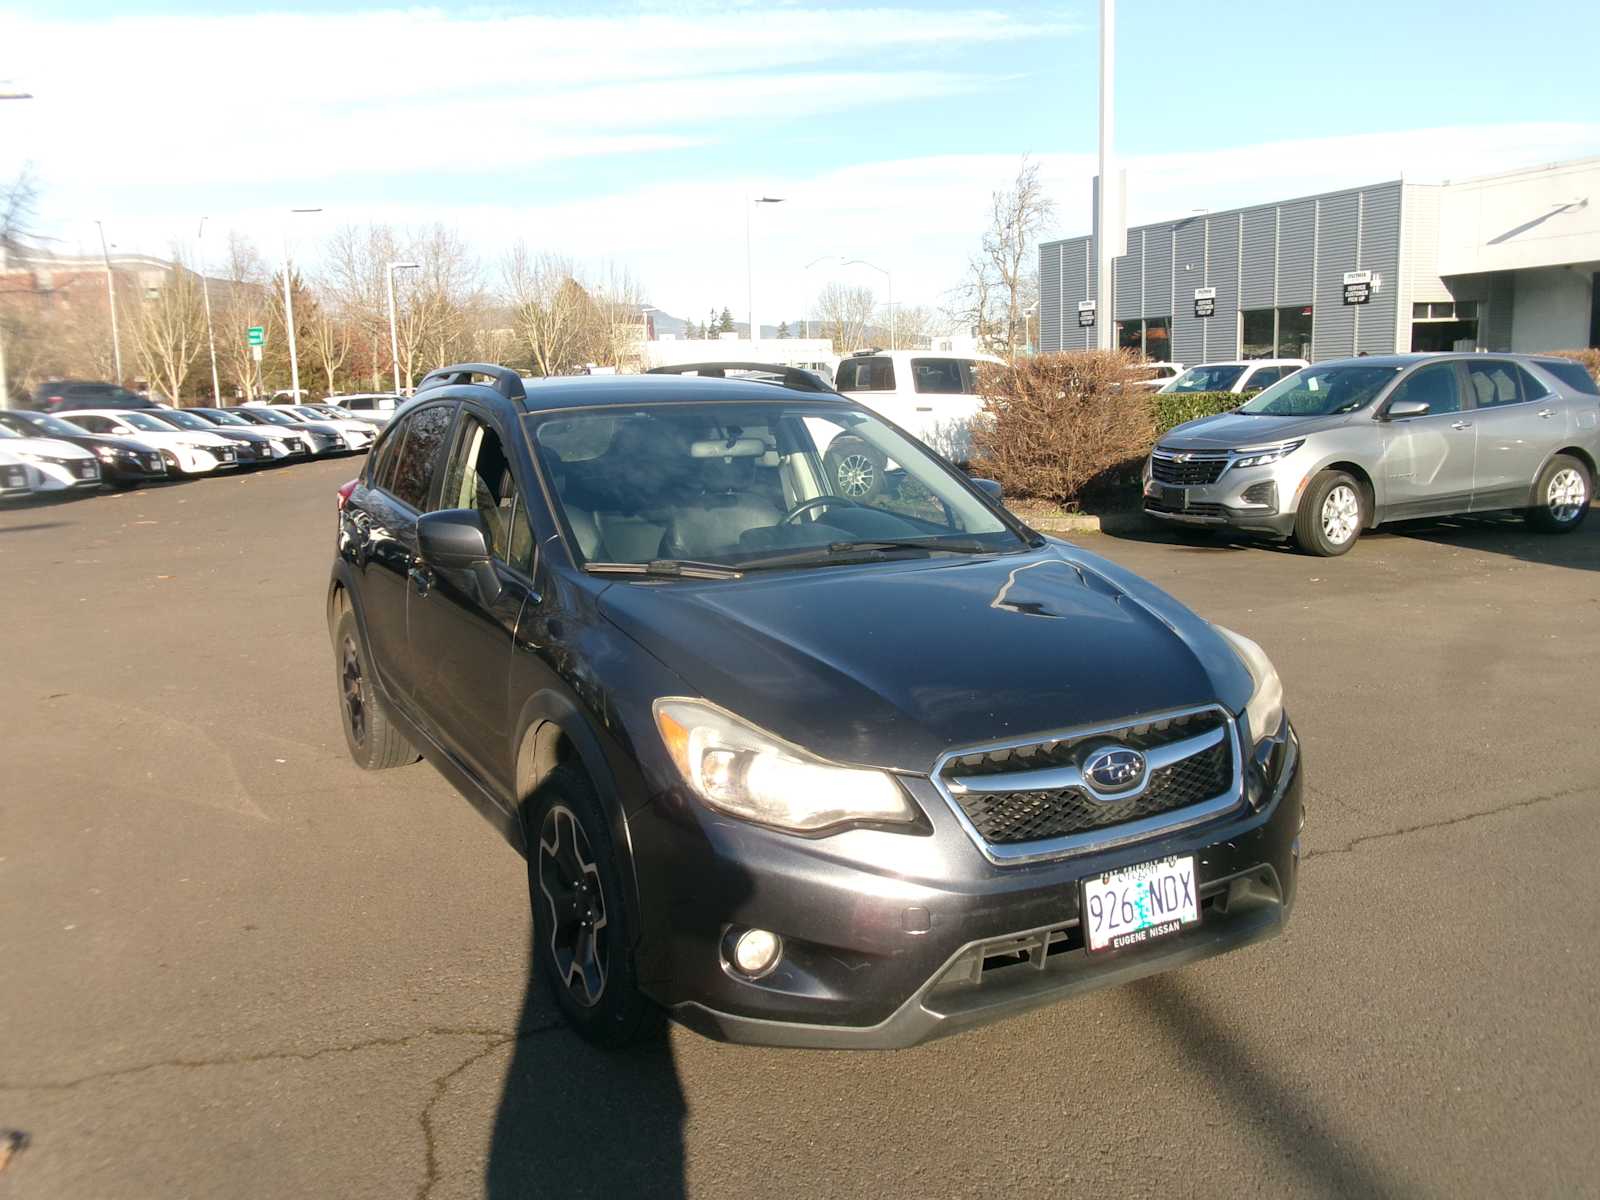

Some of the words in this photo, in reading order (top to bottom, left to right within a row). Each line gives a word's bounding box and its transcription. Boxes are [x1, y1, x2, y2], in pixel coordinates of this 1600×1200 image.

[1089, 887, 1134, 933] 926
[1149, 871, 1193, 916] NDX
[1113, 932, 1146, 948] EUGENE
[1149, 921, 1180, 937] NISSAN
